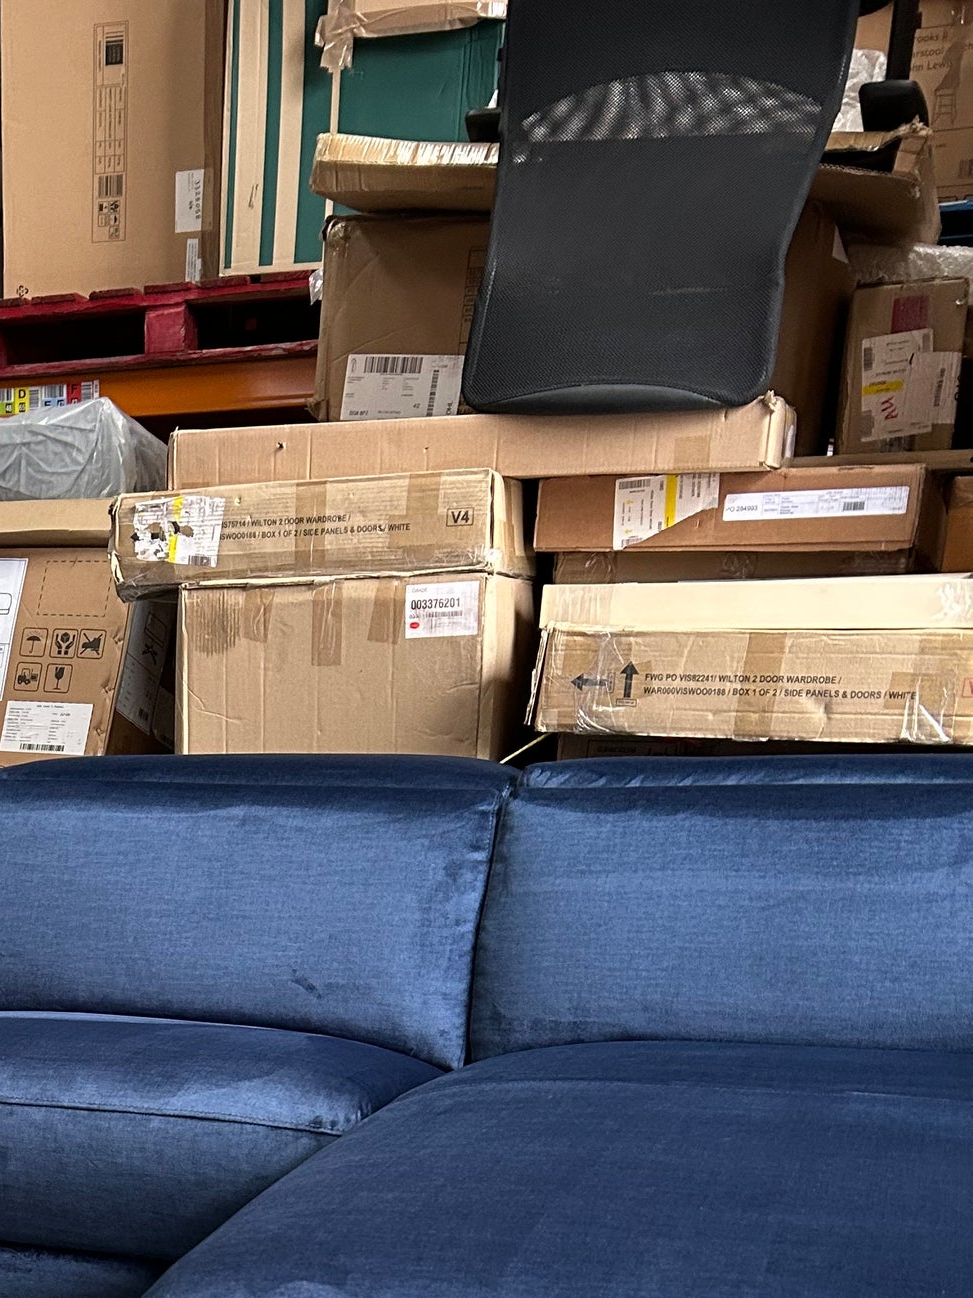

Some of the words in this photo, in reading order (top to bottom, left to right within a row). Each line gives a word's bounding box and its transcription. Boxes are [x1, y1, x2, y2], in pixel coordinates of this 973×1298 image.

[19, 389, 26, 399] D
[222, 520, 246, 528] IS75714
[251, 518, 277, 527] WILTON
[284, 517, 305, 525] DOOR
[307, 514, 347, 524] WARDROBE
[451, 510, 469, 523] V4
[261, 530, 276, 539] BOX
[278, 530, 281, 538] 1
[283, 529, 292, 537] OF
[303, 528, 319, 537] SIDE
[320, 526, 348, 536] PANELS
[349, 526, 355, 534] &
[357, 524, 382, 533] DOORS
[388, 522, 411, 531] WHITE
[410, 597, 461, 610] 003376201
[644, 673, 663, 681] FWG
[666, 673, 677, 681] PO
[718, 674, 750, 683] WILTON
[759, 675, 784, 683] DOOR
[786, 675, 837, 684] WARDROBE
[732, 688, 750, 696] BOX
[752, 688, 757, 696] 1
[759, 688, 770, 696] OF
[772, 689, 778, 697] 2
[784, 689, 804, 697] SIDE
[806, 689, 840, 698] PANELS
[842, 690, 848, 698] &
[850, 690, 882, 699] DOORS
[888, 691, 917, 700] WHITE
